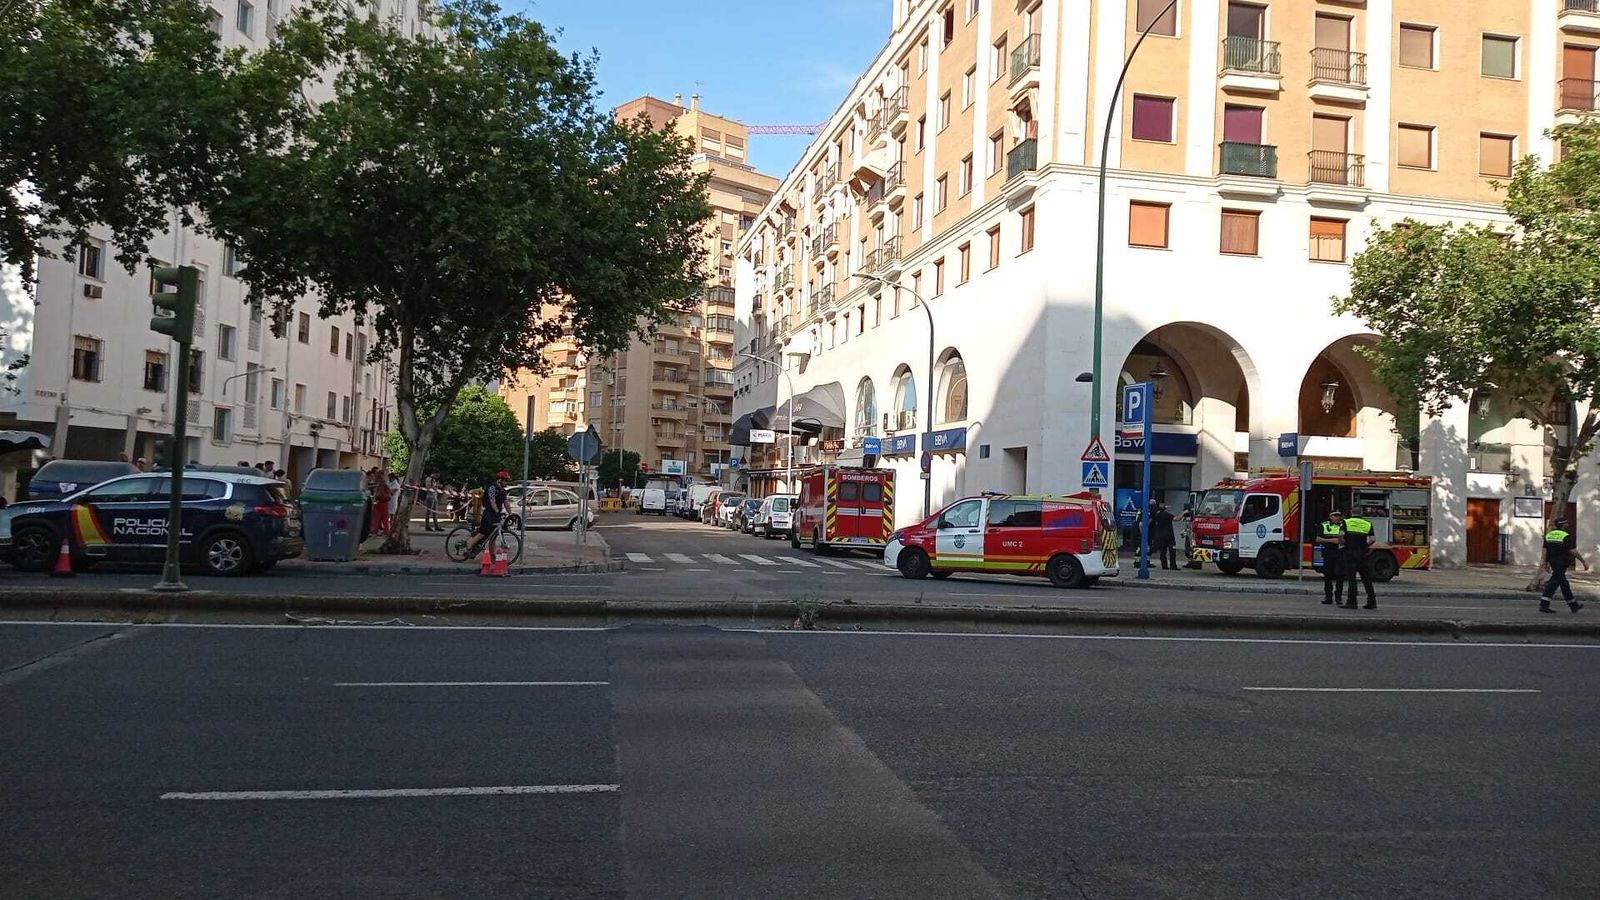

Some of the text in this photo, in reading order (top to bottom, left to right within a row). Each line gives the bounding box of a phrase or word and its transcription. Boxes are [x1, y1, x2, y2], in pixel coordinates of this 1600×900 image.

[1128, 391, 1140, 419] P
[896, 438, 908, 450] BBVA
[934, 433, 948, 446] BBVA
[1281, 441, 1295, 449] BBVA
[842, 474, 879, 482] BOMBEROS
[113, 527, 193, 536] NACIONL
